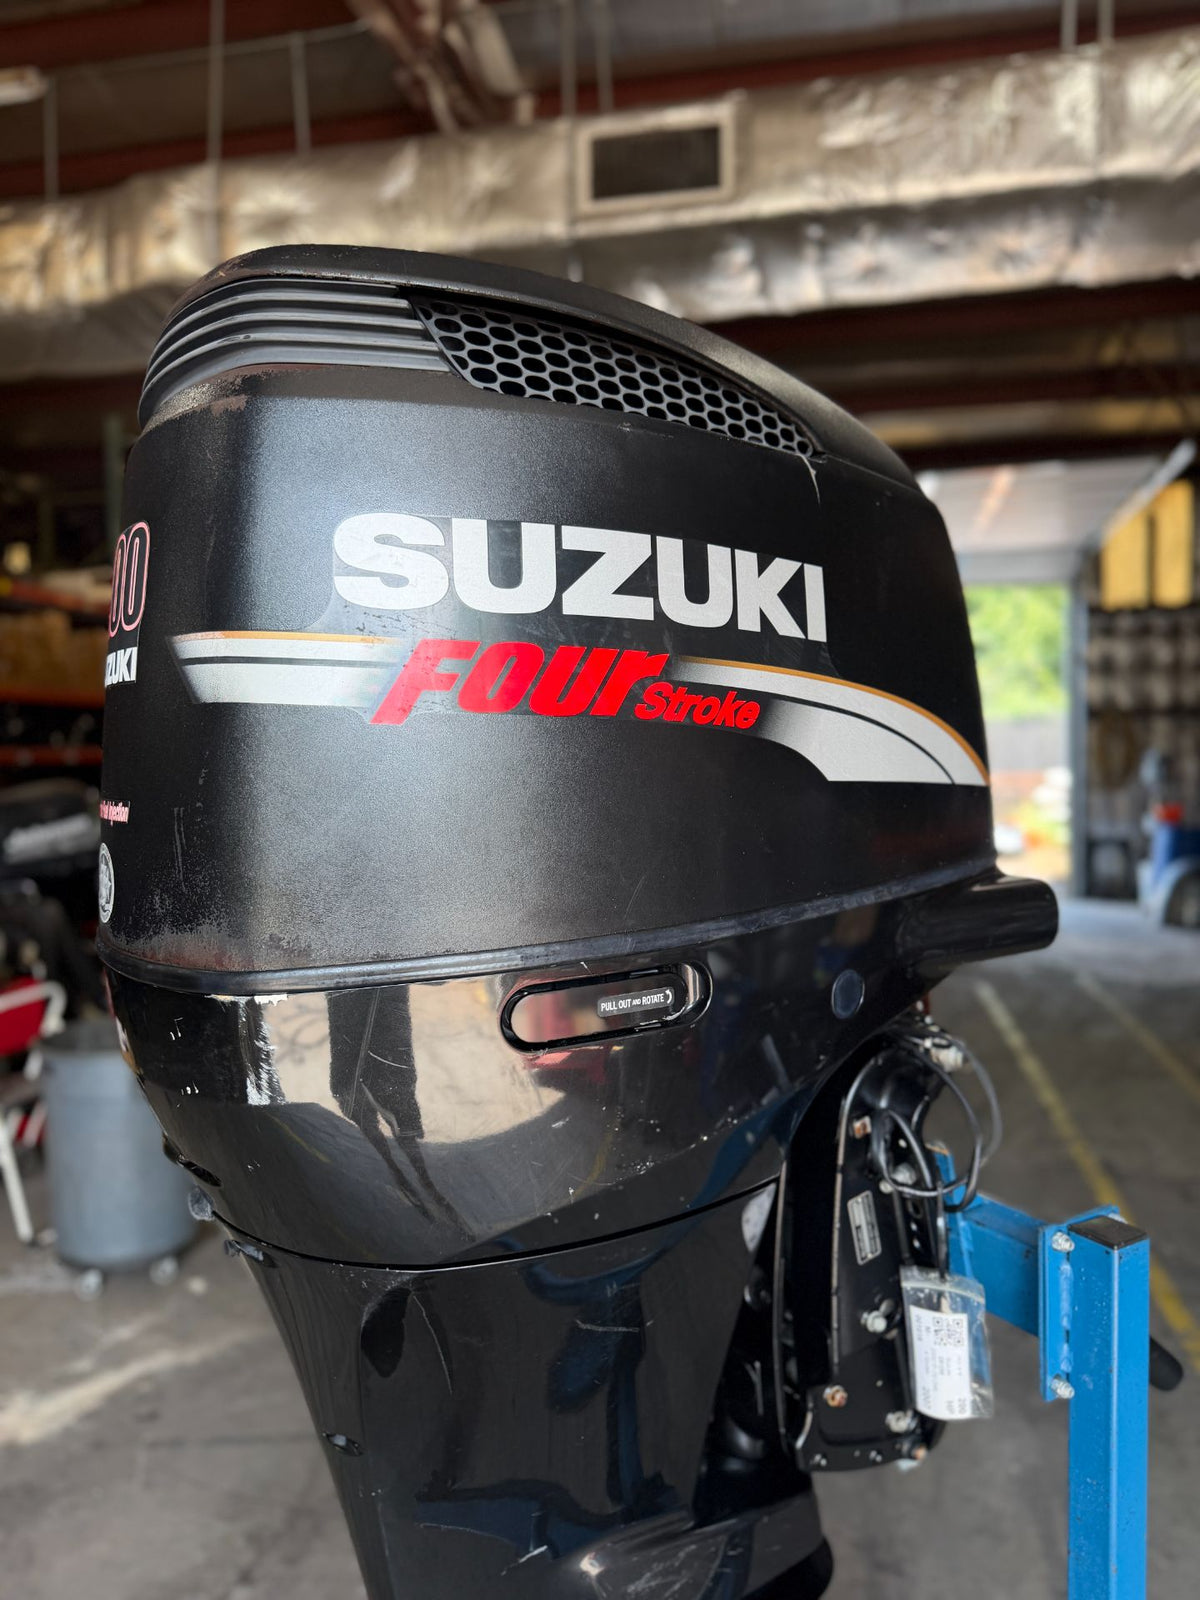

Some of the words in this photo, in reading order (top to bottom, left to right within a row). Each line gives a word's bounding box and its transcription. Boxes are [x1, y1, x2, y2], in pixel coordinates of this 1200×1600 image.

[108, 521, 150, 637] 00
[333, 512, 827, 643] SUZUKI
[104, 646, 138, 686] ZUKI
[634, 681, 760, 729] Stroke
[601, 1001, 618, 1011] PULL
[618, 998, 631, 1009] OUT
[642, 993, 665, 1005] ROTATE
